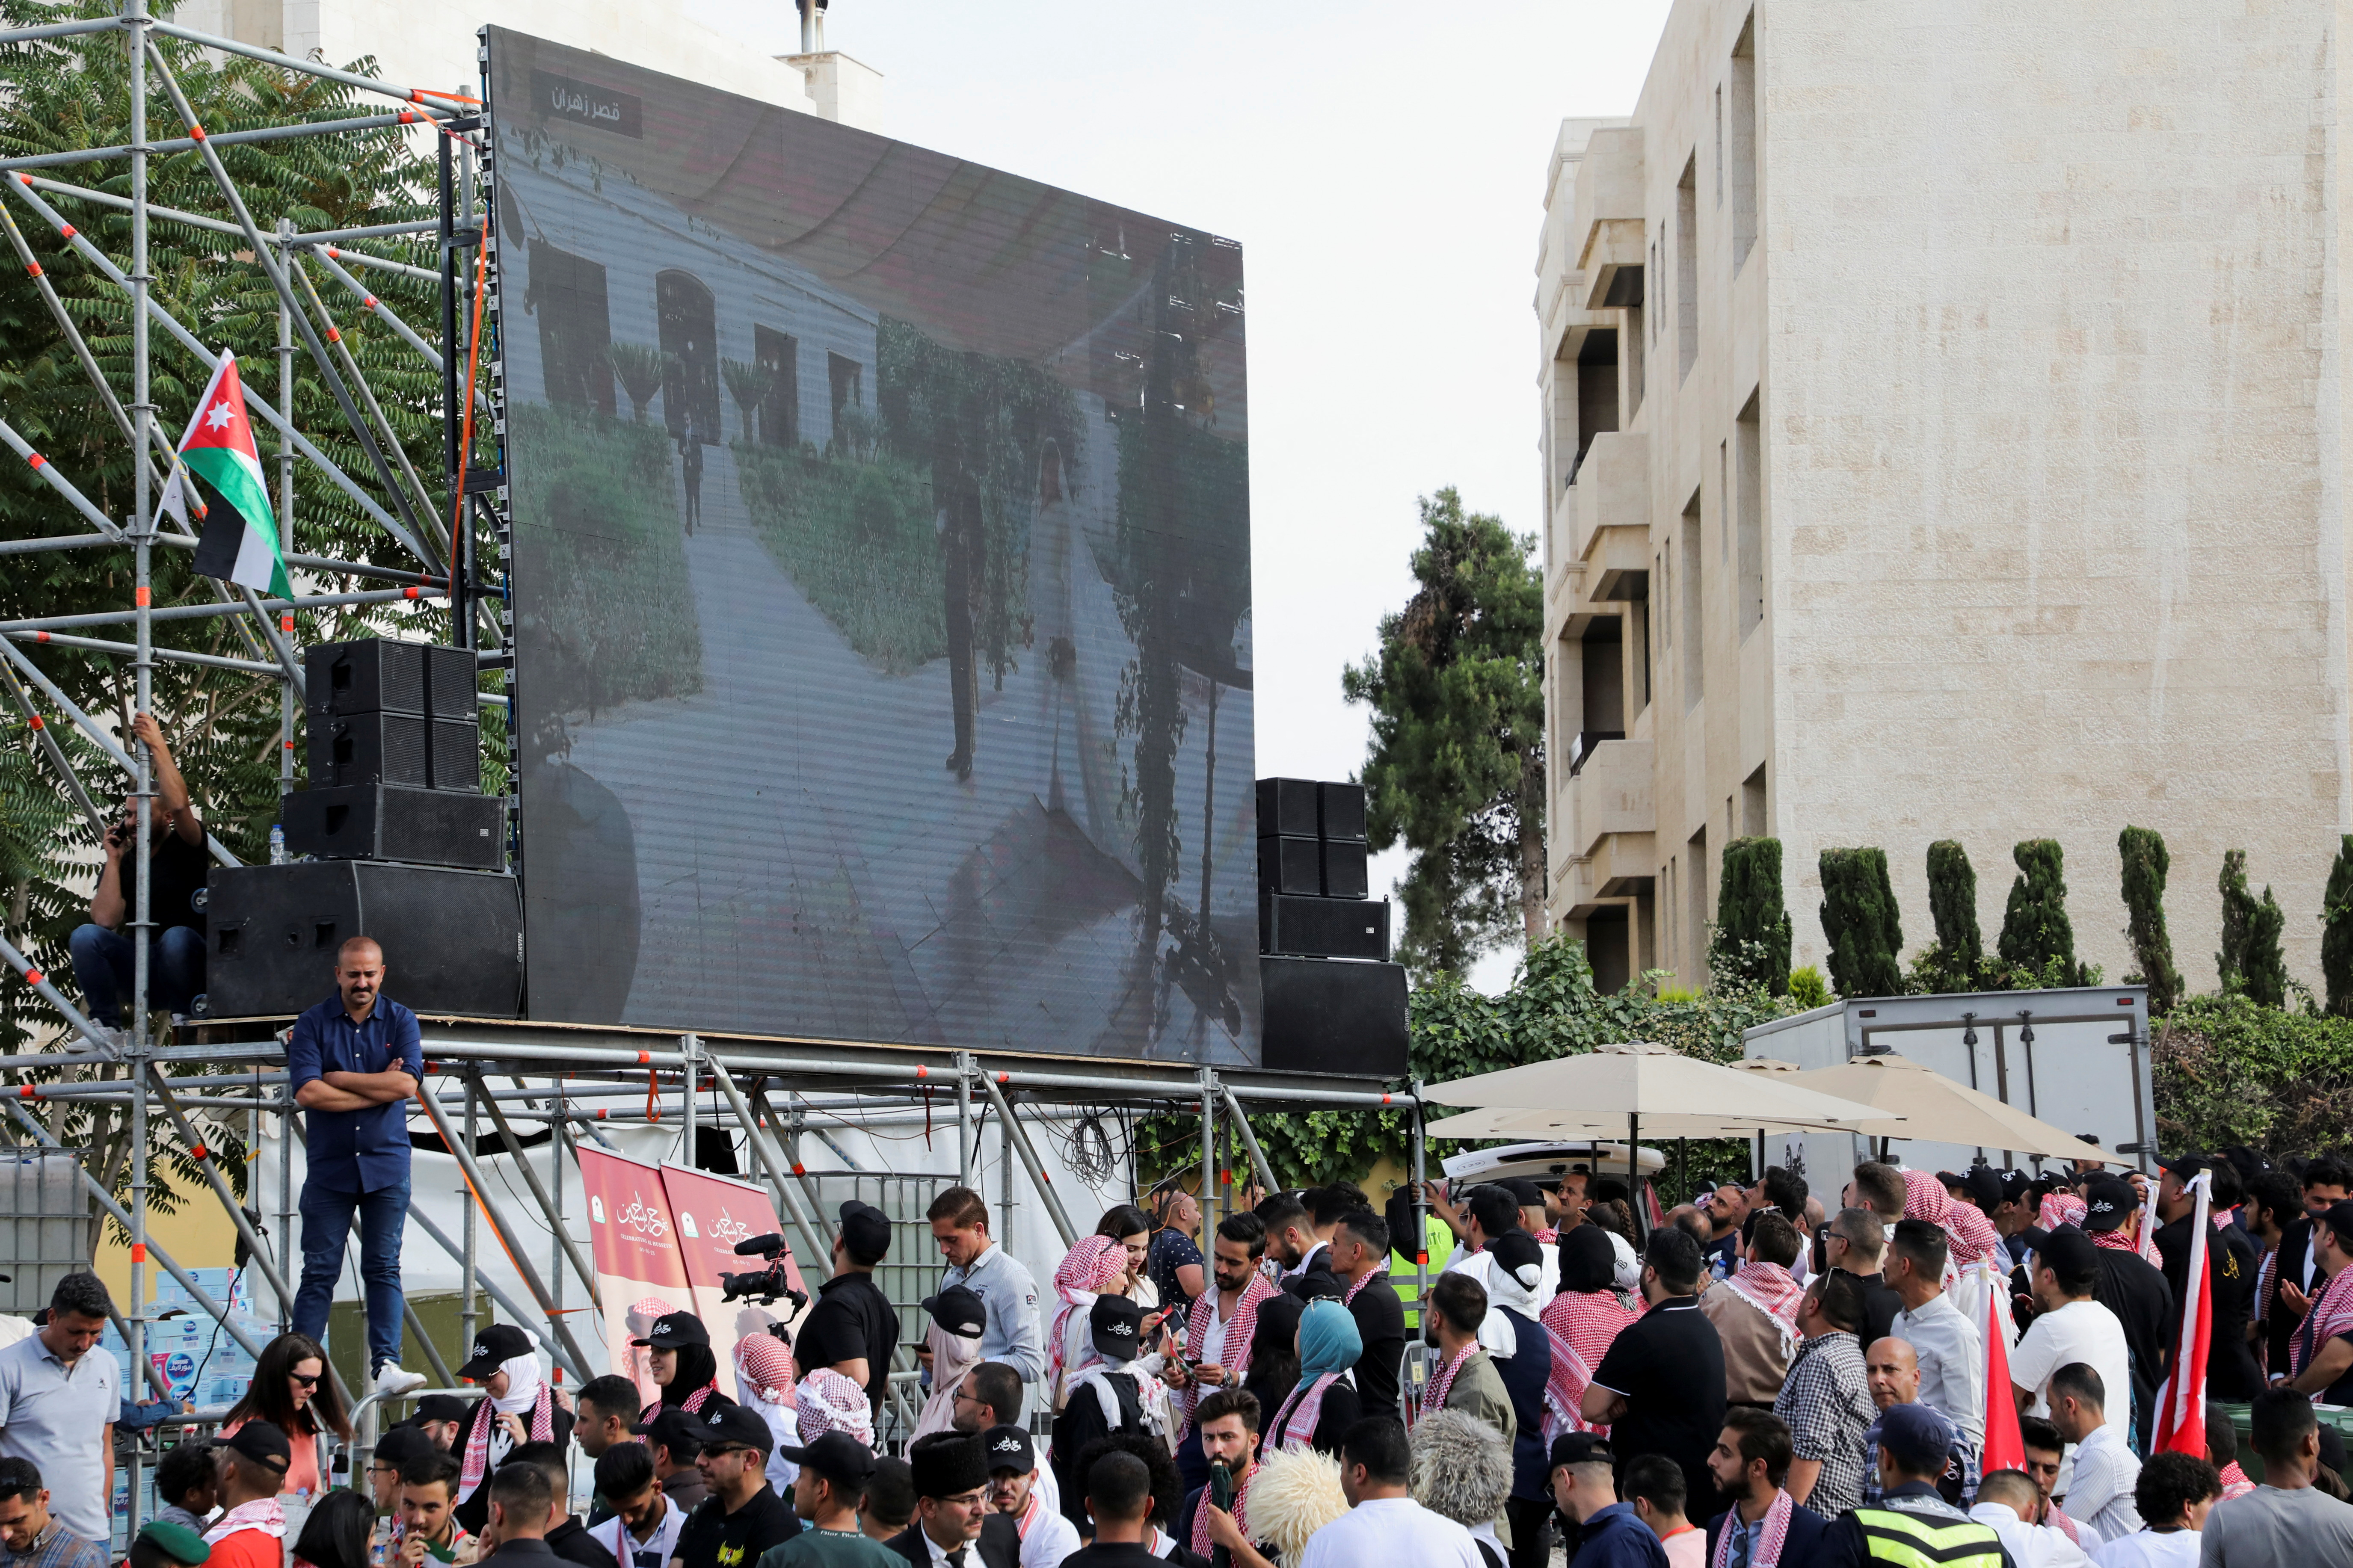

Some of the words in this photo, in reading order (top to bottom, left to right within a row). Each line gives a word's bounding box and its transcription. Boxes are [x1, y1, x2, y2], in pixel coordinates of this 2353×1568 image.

[551, 86, 588, 117] زهران
[592, 102, 620, 121] قصر
[1461, 1161, 1482, 1169] 129
[620, 1233, 647, 1244] CELEBRATING
[639, 1247, 655, 1256] 01-06-23
[714, 1247, 736, 1255] CELEBRATI
